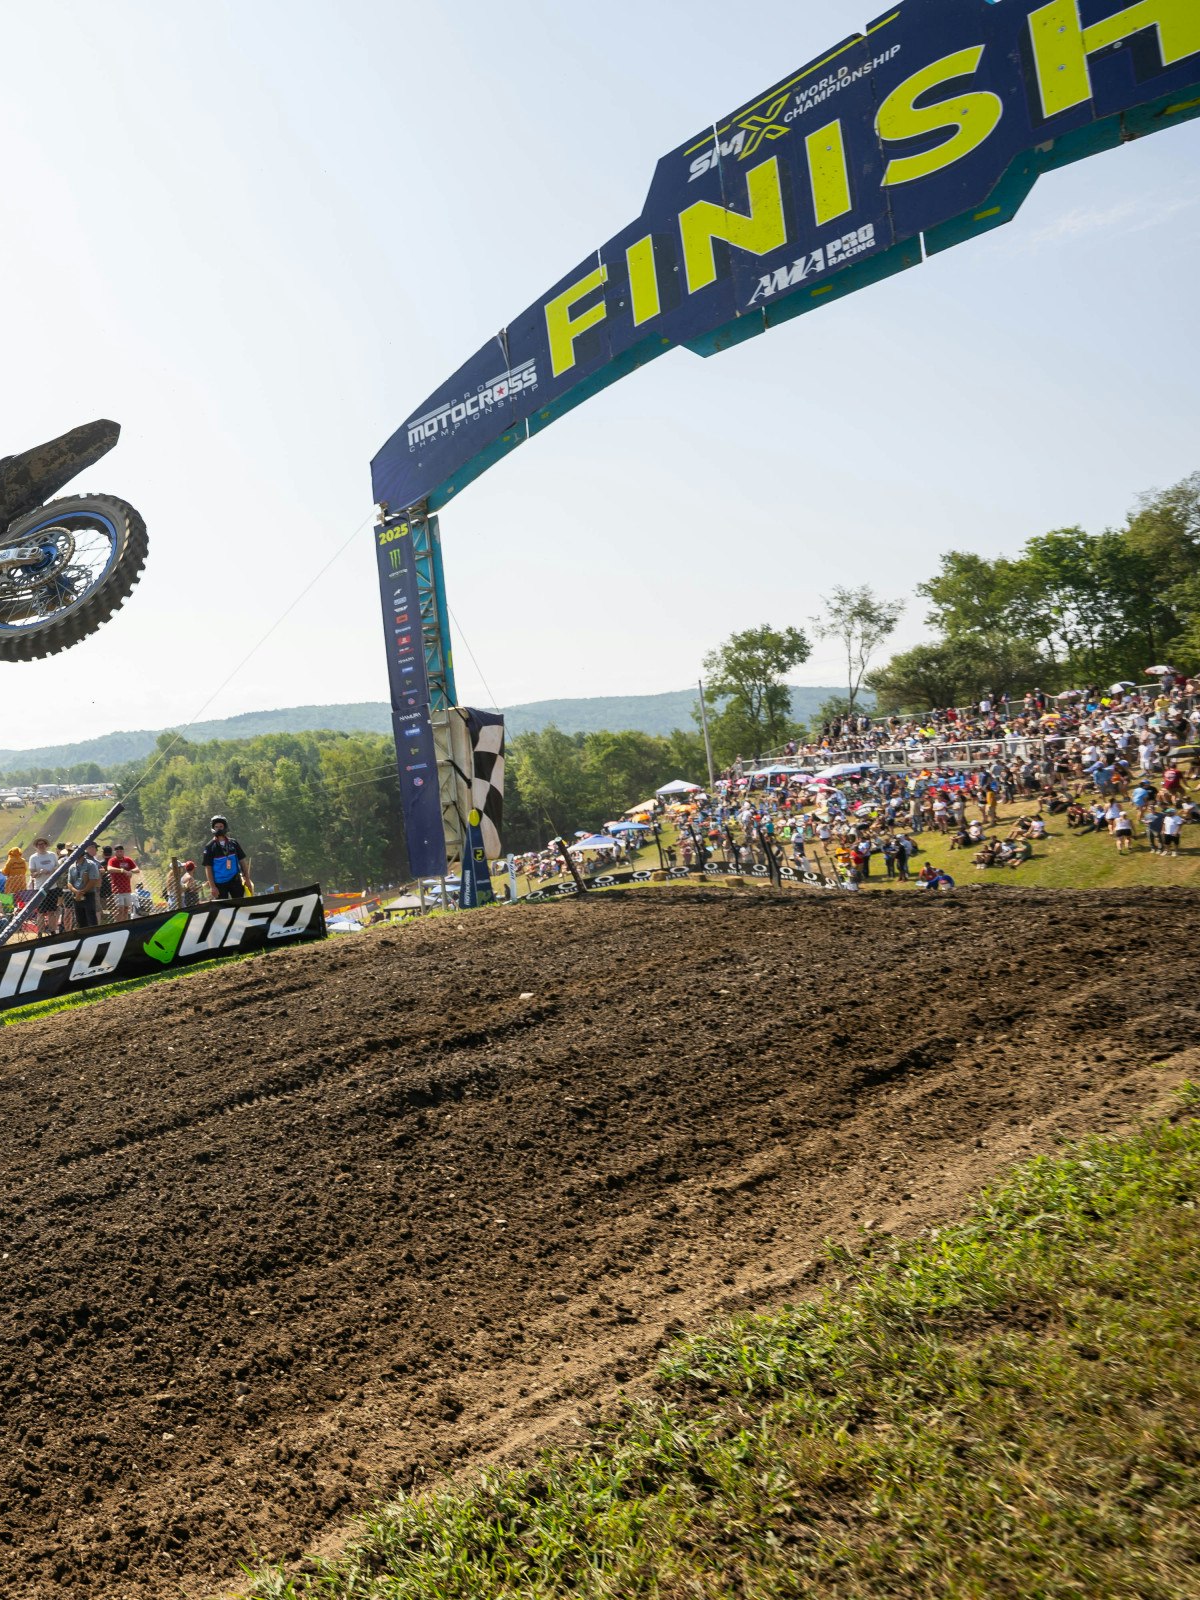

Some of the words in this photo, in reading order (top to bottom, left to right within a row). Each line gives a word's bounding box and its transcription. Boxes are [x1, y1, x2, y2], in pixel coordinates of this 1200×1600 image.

[784, 44, 901, 123] CHAMPIONSHIP
[795, 66, 849, 105] WORLD
[687, 92, 791, 183] SMX
[544, 0, 1200, 378] FINISH
[826, 223, 875, 259] PRO
[827, 238, 876, 267] RACING
[746, 248, 825, 306] AMA
[407, 366, 538, 447] MOTOCROSS
[409, 384, 539, 453] CHAMPIONSHIP
[451, 384, 485, 406] PRO
[379, 523, 409, 545] 2025
[179, 893, 318, 957] UFO
[270, 926, 305, 937] PLAST
[72, 966, 114, 979] PLAST
